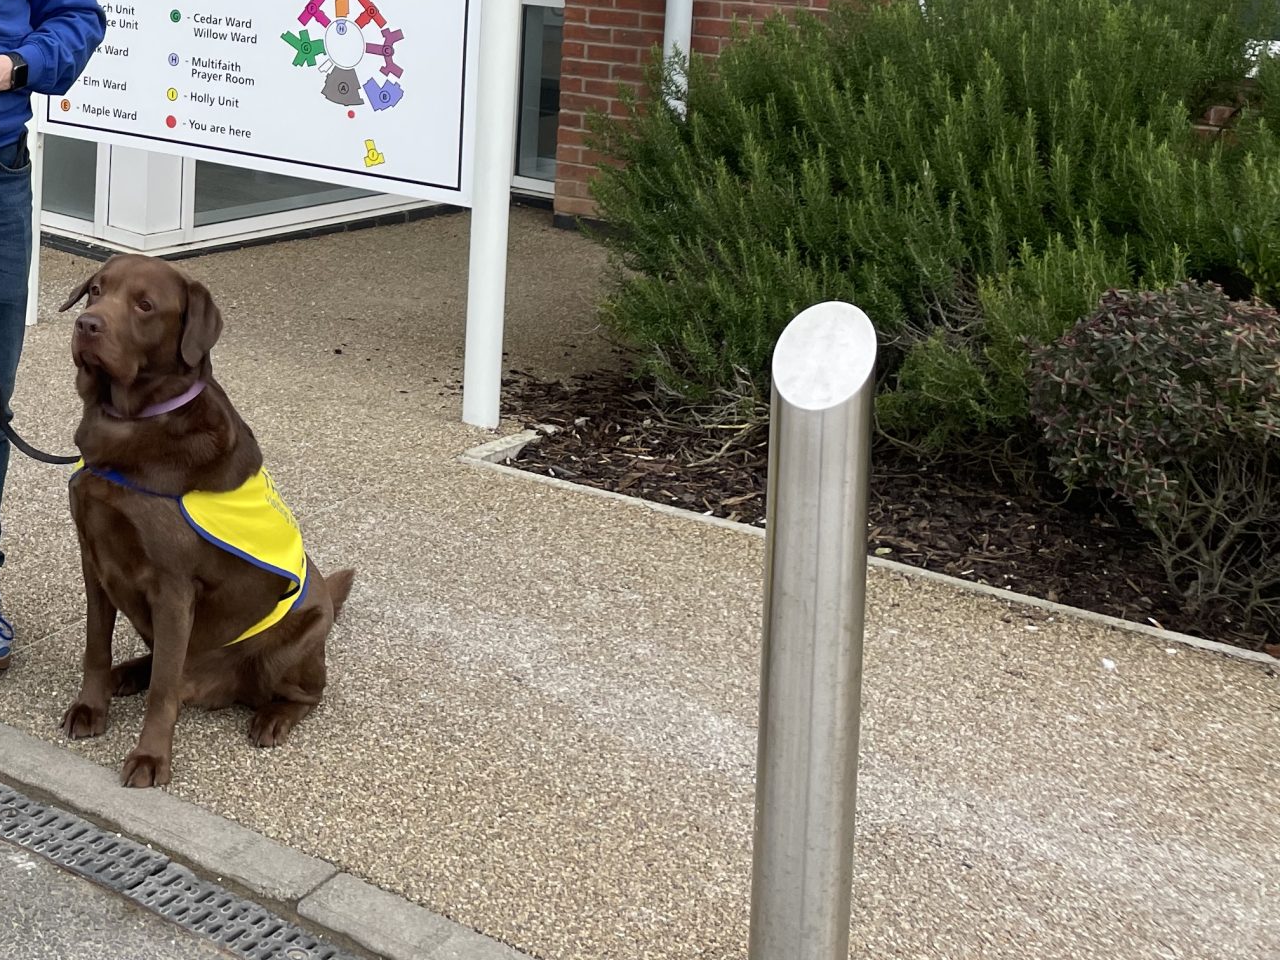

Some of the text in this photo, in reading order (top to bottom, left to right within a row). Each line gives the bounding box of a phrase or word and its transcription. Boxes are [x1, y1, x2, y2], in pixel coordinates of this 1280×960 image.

[115, 4, 135, 16] Unit
[119, 19, 139, 30] Unit
[193, 13, 222, 25] Cedar
[225, 16, 252, 29] Ward
[193, 27, 258, 44] Willow Ward
[104, 44, 129, 57] Ward
[191, 56, 241, 72] Multifaith
[83, 76, 127, 91] Elm Ward
[191, 68, 255, 86] Prayer Room
[190, 91, 215, 106] Holly
[218, 95, 239, 108] Unit
[82, 103, 110, 117] Maple
[113, 108, 137, 121] Ward
[188, 118, 252, 138] You are here
